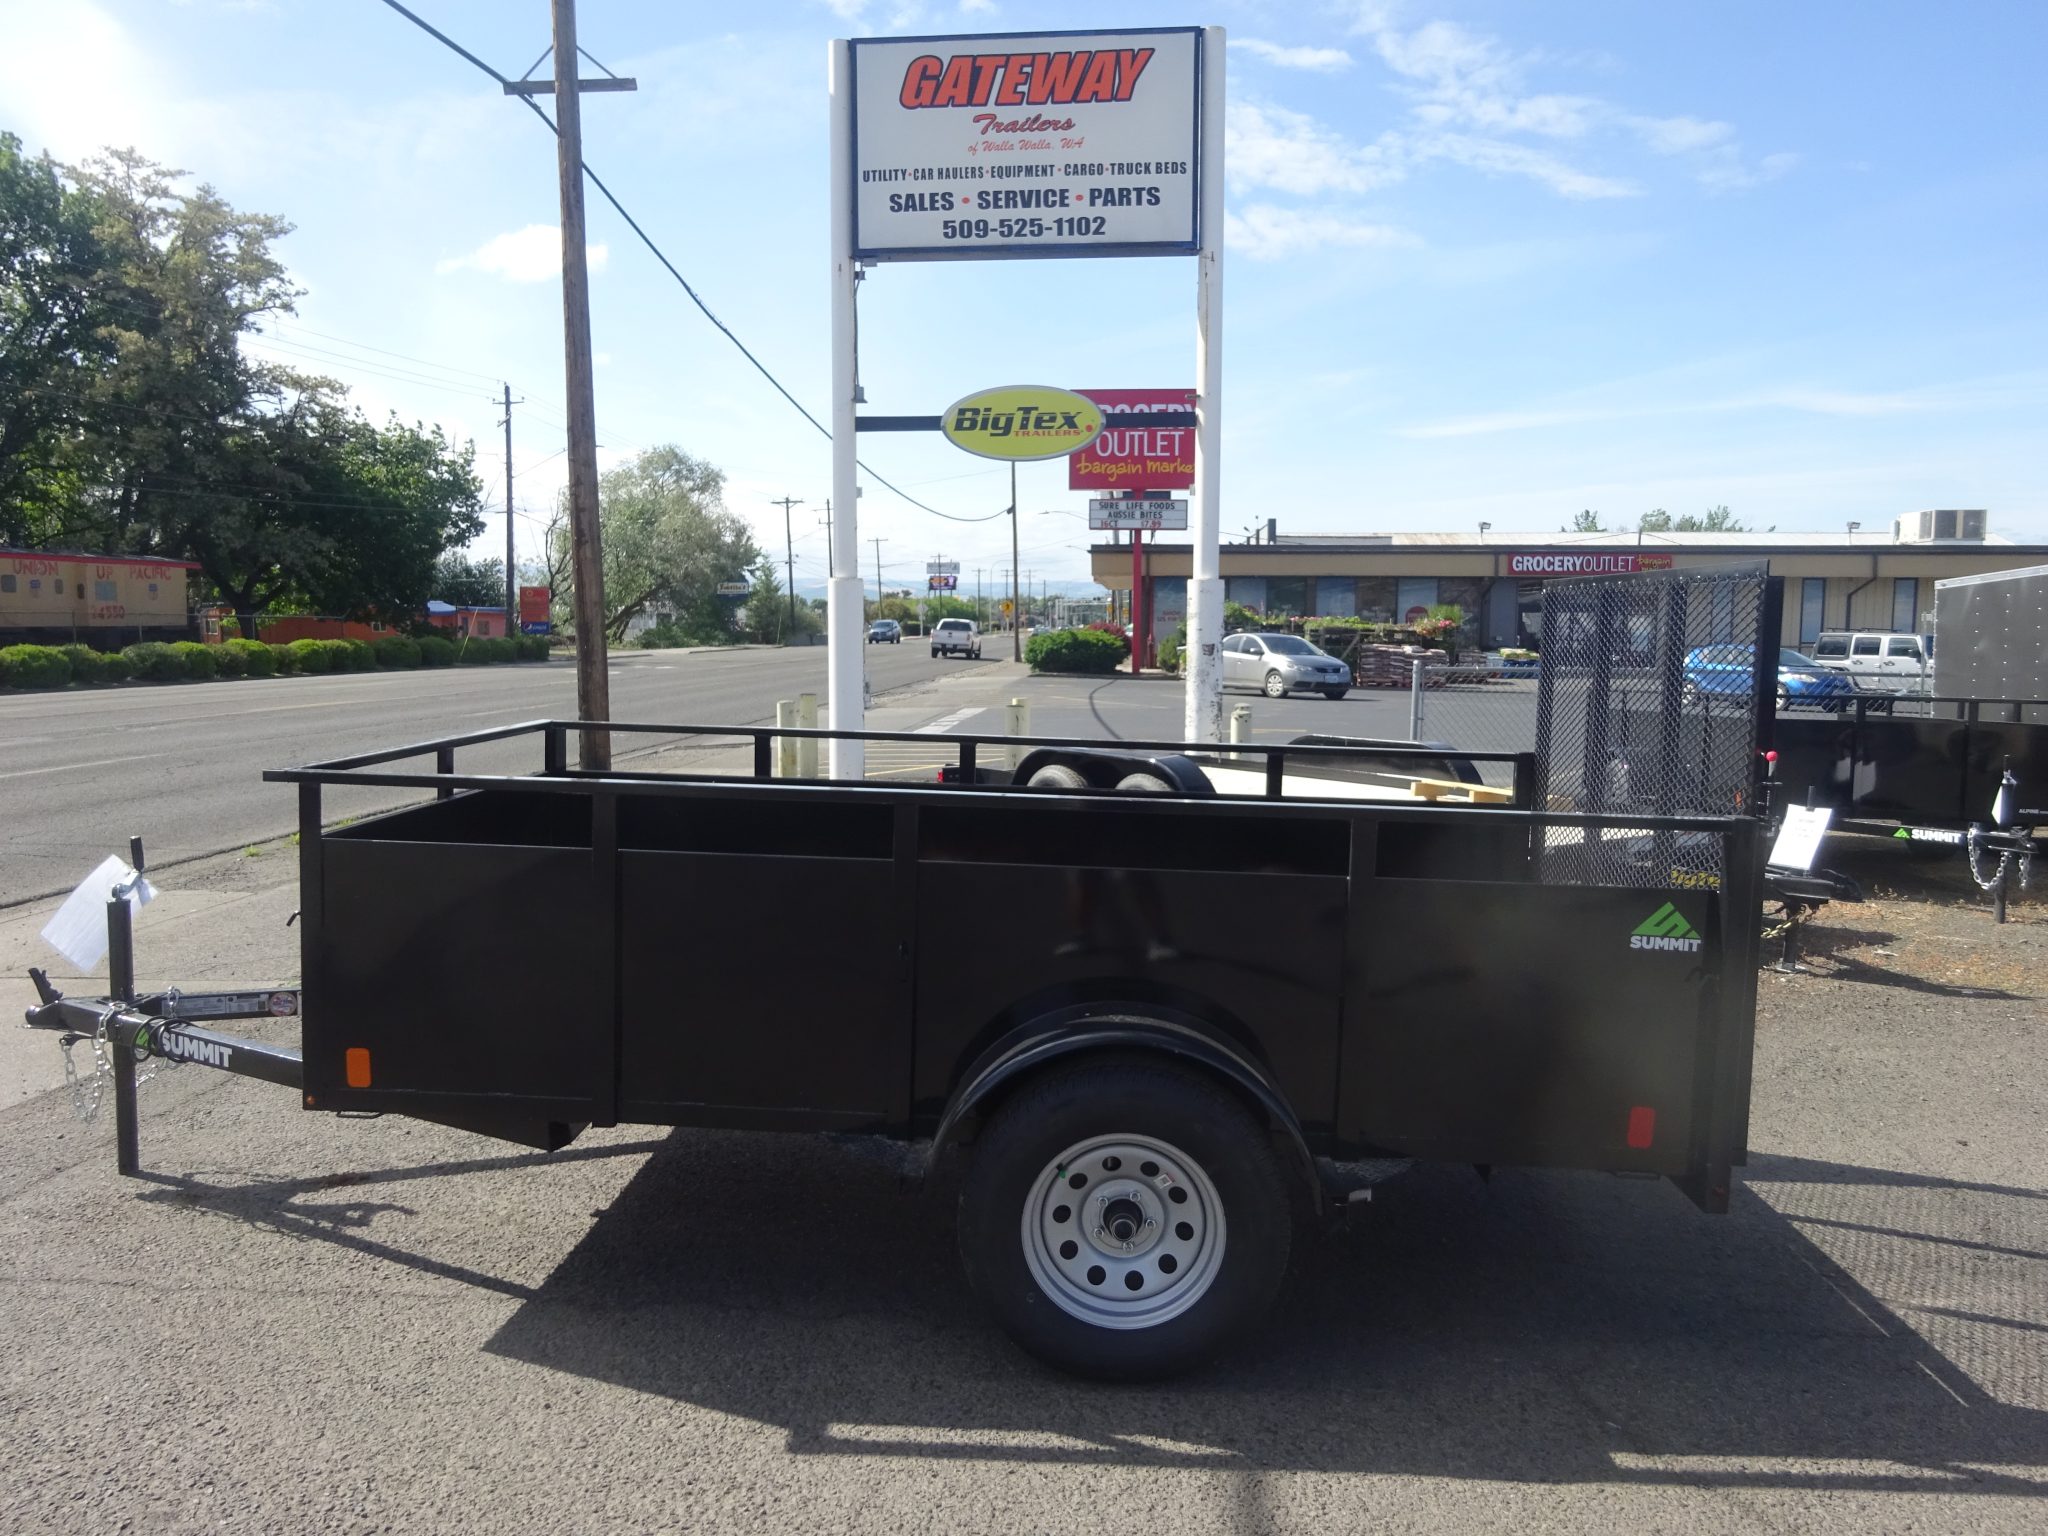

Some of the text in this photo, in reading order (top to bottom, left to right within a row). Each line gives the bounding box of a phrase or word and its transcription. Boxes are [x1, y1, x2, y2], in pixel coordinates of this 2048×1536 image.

[899, 48, 1155, 109] GATEWAY
[972, 113, 1076, 135] Trailers
[968, 142, 978, 156] of
[982, 141, 1015, 152] Walla
[1060, 137, 1085, 149] WA
[862, 161, 1187, 182] UTILITY CAR HAULERS EQUIPMENT CARGO TRUCK BEDS
[889, 187, 1161, 212] SALES SERVICE PARTS
[943, 216, 1106, 239] 509-525-1102
[1096, 431, 1184, 456] OUTLET
[1076, 454, 1195, 481] bargain marke
[1099, 502, 1175, 510] SURE LIFE FOODS
[1108, 511, 1163, 519] AUSSIE BITES
[13, 559, 59, 576] UNION
[1637, 554, 1670, 568] bargain
[96, 566, 172, 581] UP PACIFIC
[1911, 829, 1962, 844] SUMMIT
[1630, 935, 1702, 952] SUMMIT
[162, 1030, 233, 1068] SUMMIT
